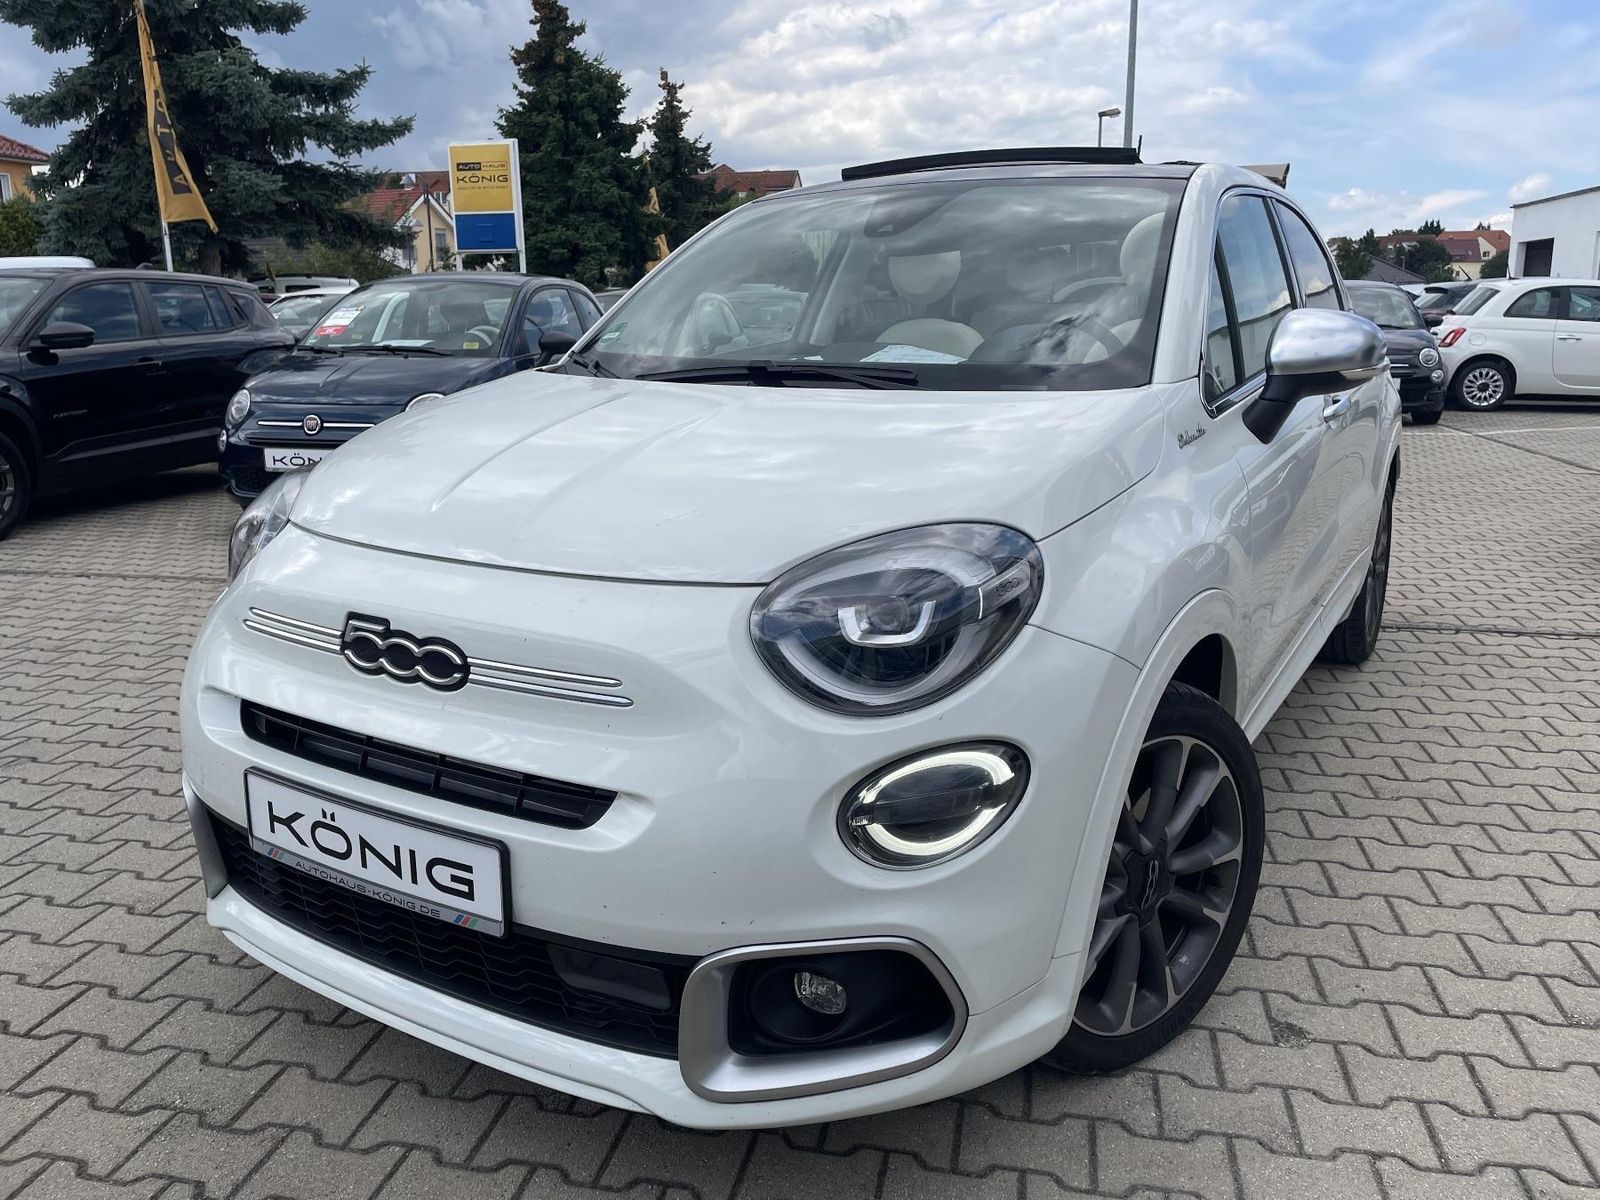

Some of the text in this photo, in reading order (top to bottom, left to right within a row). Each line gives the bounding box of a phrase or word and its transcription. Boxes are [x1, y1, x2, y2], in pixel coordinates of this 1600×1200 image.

[456, 172, 508, 184] KÖNIG
[341, 612, 472, 692] 500
[267, 800, 475, 902] KÖNIG
[295, 860, 441, 918] AUTOHAUS-KÖNIG.DE
